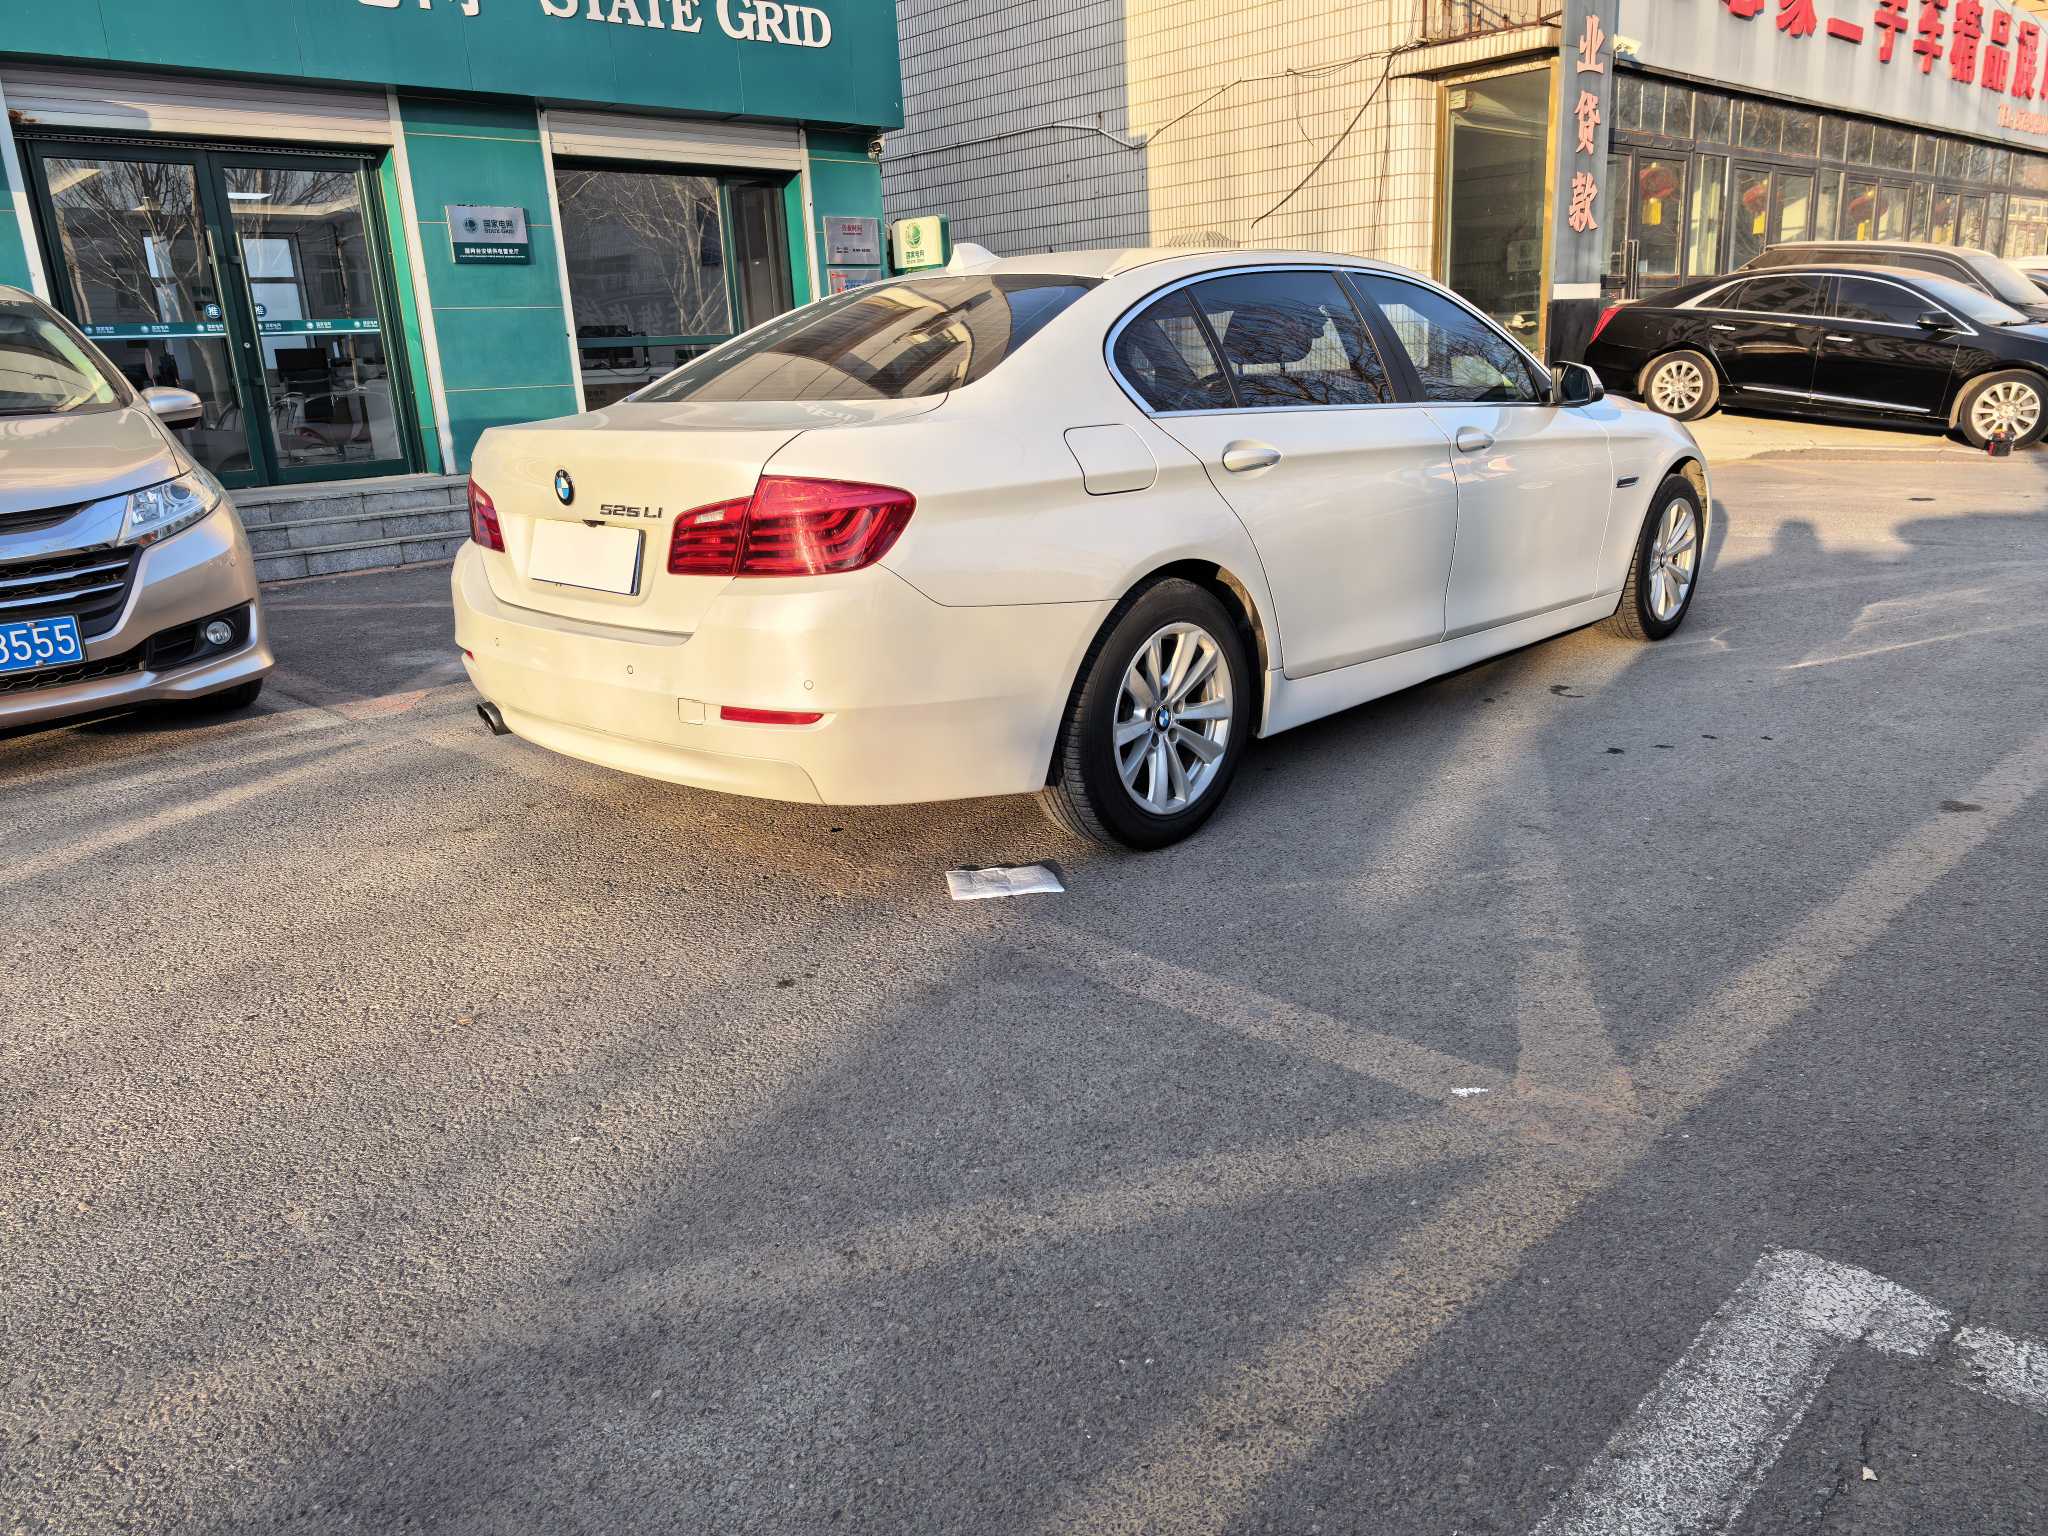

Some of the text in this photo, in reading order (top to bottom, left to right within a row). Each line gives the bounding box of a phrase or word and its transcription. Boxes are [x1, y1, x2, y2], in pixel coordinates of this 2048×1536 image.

[716, 0, 832, 48] GRID
[1720, 0, 2048, 101] 手车精品展
[1569, 15, 1605, 233] 业贷款
